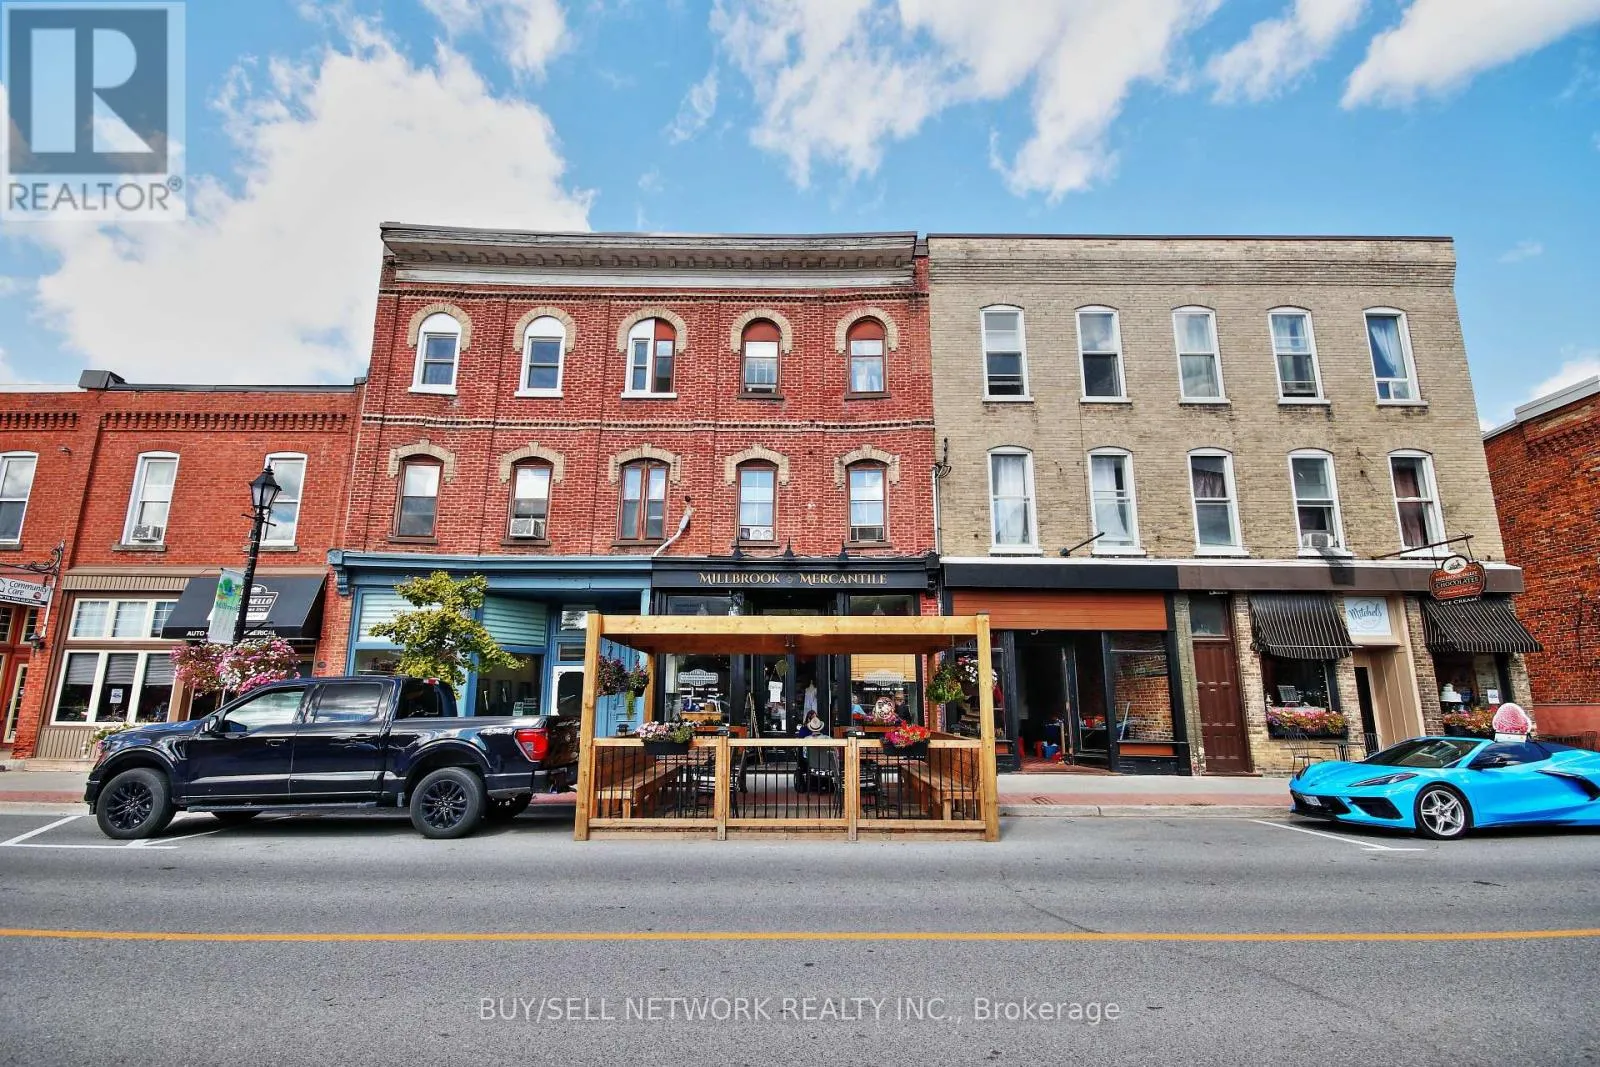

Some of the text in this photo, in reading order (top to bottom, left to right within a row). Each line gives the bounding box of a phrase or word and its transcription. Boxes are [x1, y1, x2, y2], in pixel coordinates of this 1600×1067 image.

[699, 572, 888, 587] MILLBROOK MERCANTILE
[8, 588, 25, 597] Care
[9, 580, 49, 596] Community
